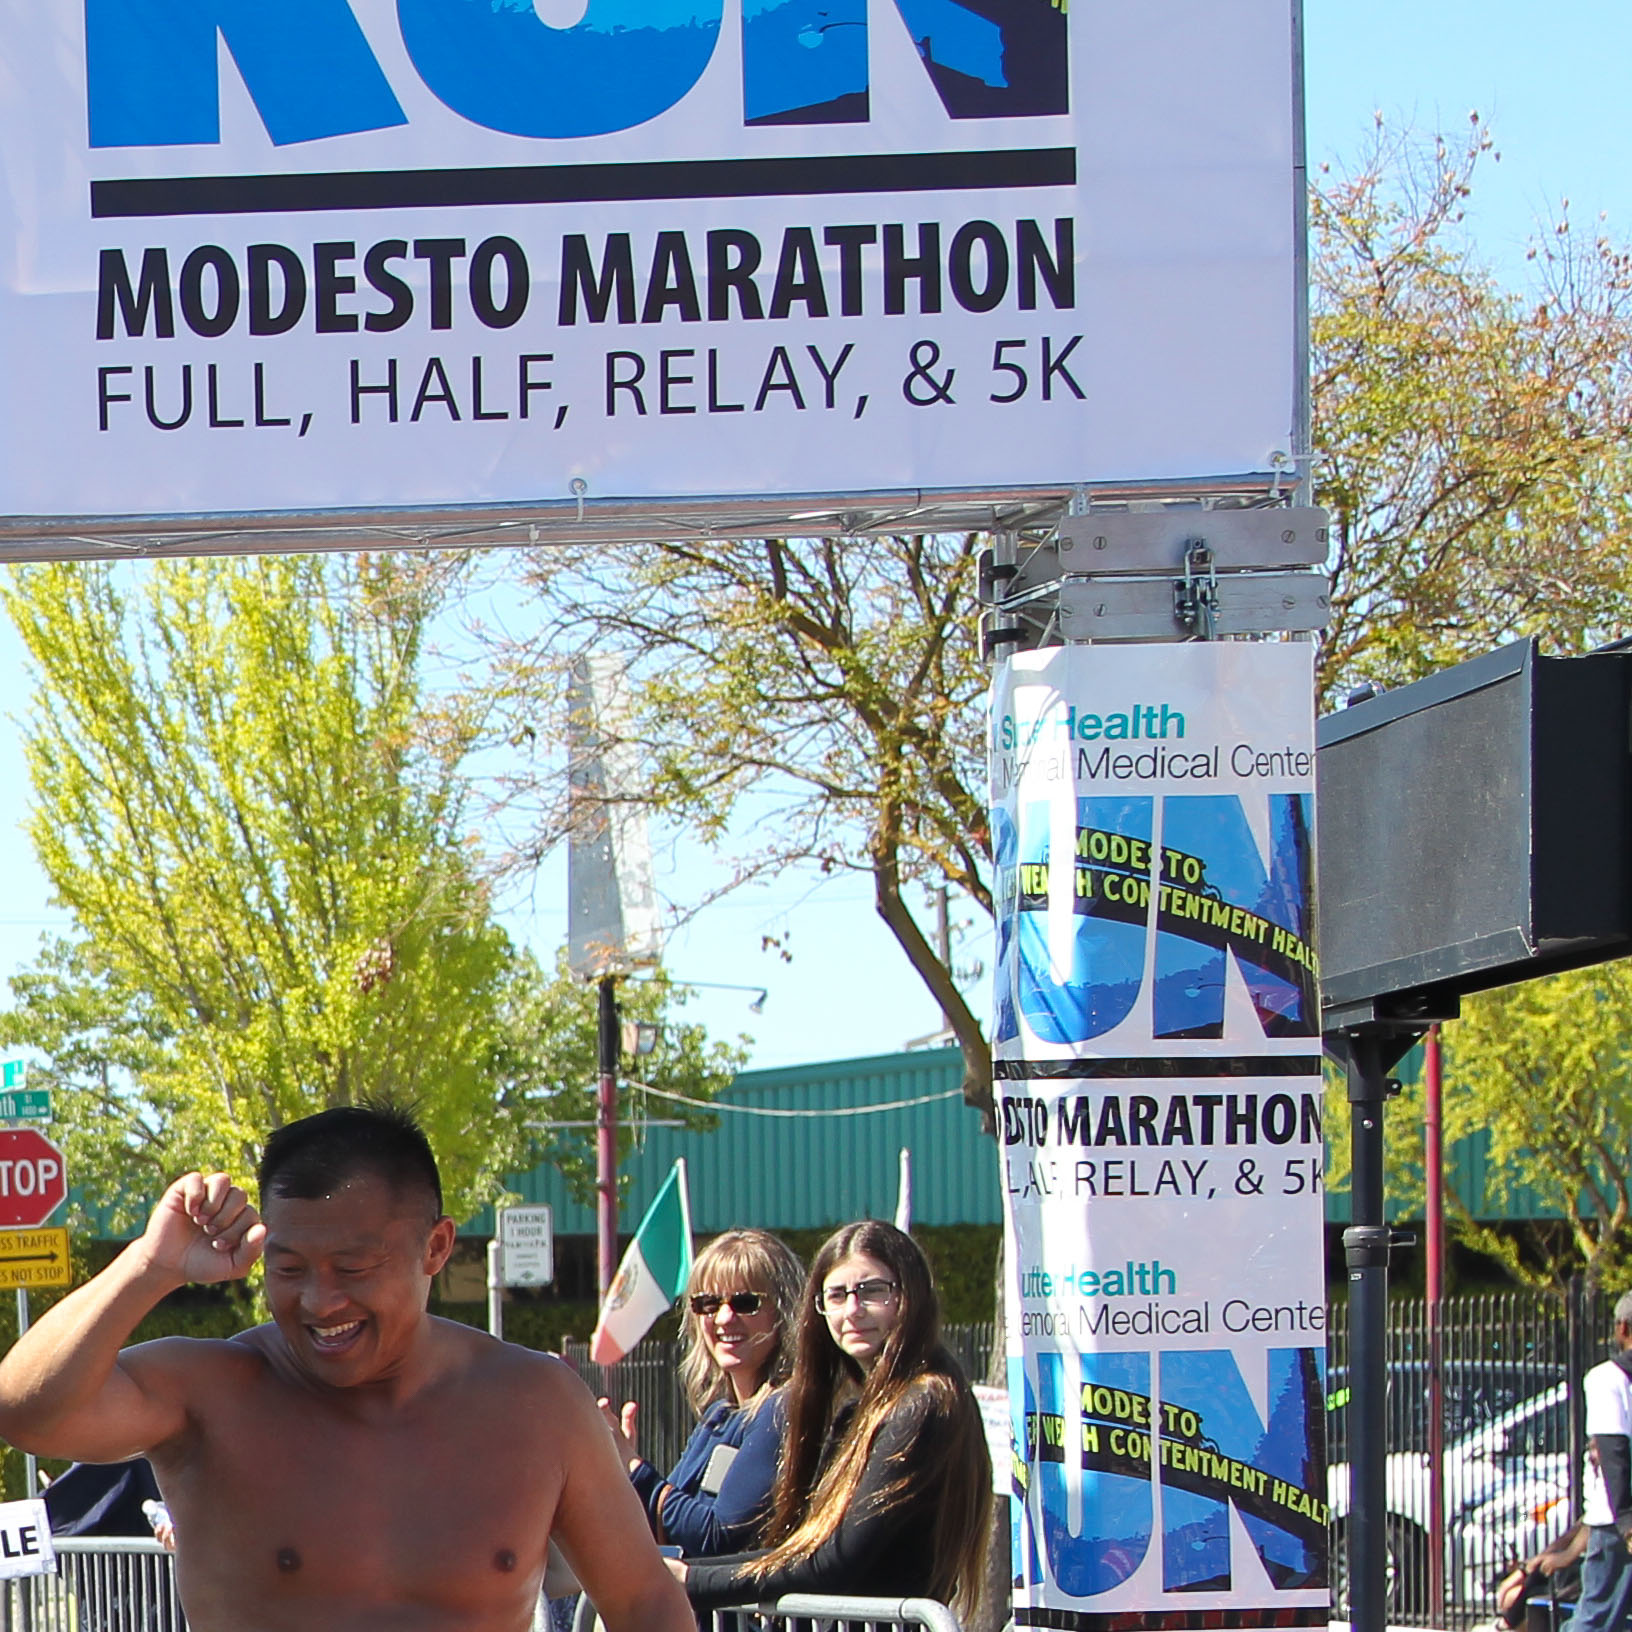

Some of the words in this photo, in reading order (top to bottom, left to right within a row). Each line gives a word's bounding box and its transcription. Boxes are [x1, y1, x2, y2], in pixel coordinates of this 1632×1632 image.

[96, 235, 531, 343] MODESTO
[557, 216, 1078, 328] MARATHON
[97, 360, 314, 438] FULL,
[347, 352, 570, 431] HALF,
[604, 341, 867, 421] RELAY,
[902, 339, 957, 408] &
[989, 334, 1088, 404] 5K
[1077, 745, 1219, 781] Medical
[1056, 1093, 1324, 1147] MARATHON
[1075, 1159, 1216, 1200] RELAY,
[1235, 1158, 1264, 1197] &
[17, 1234, 61, 1249] TRAFFIC
[11, 1268, 34, 1282] NOT
[36, 1266, 65, 1281] STOP
[1079, 1302, 1210, 1338] Medical
